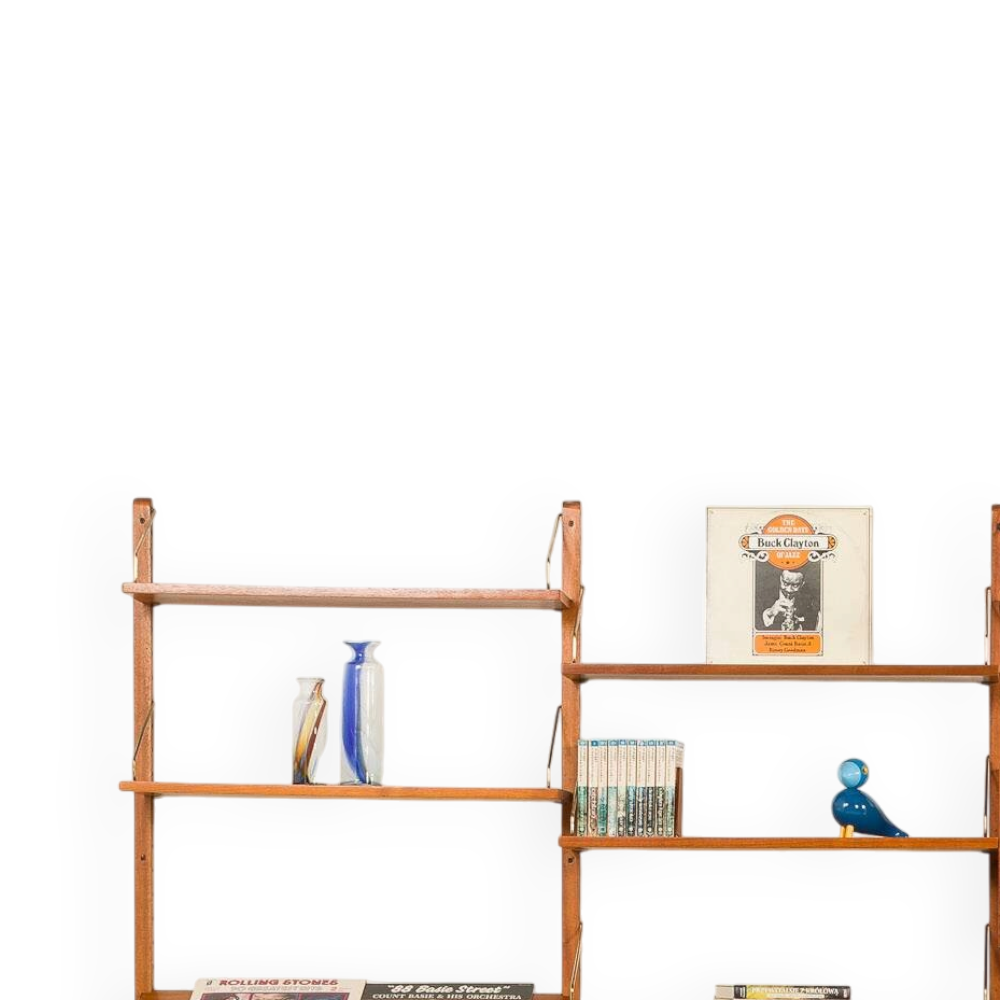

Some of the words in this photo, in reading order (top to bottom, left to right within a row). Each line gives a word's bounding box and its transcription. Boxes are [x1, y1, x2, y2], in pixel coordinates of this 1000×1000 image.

[757, 537, 782, 548] Buck
[783, 537, 819, 549] Clayton
[218, 978, 279, 986] ROLLING
[282, 978, 339, 986] STONES
[415, 984, 454, 994] Basie
